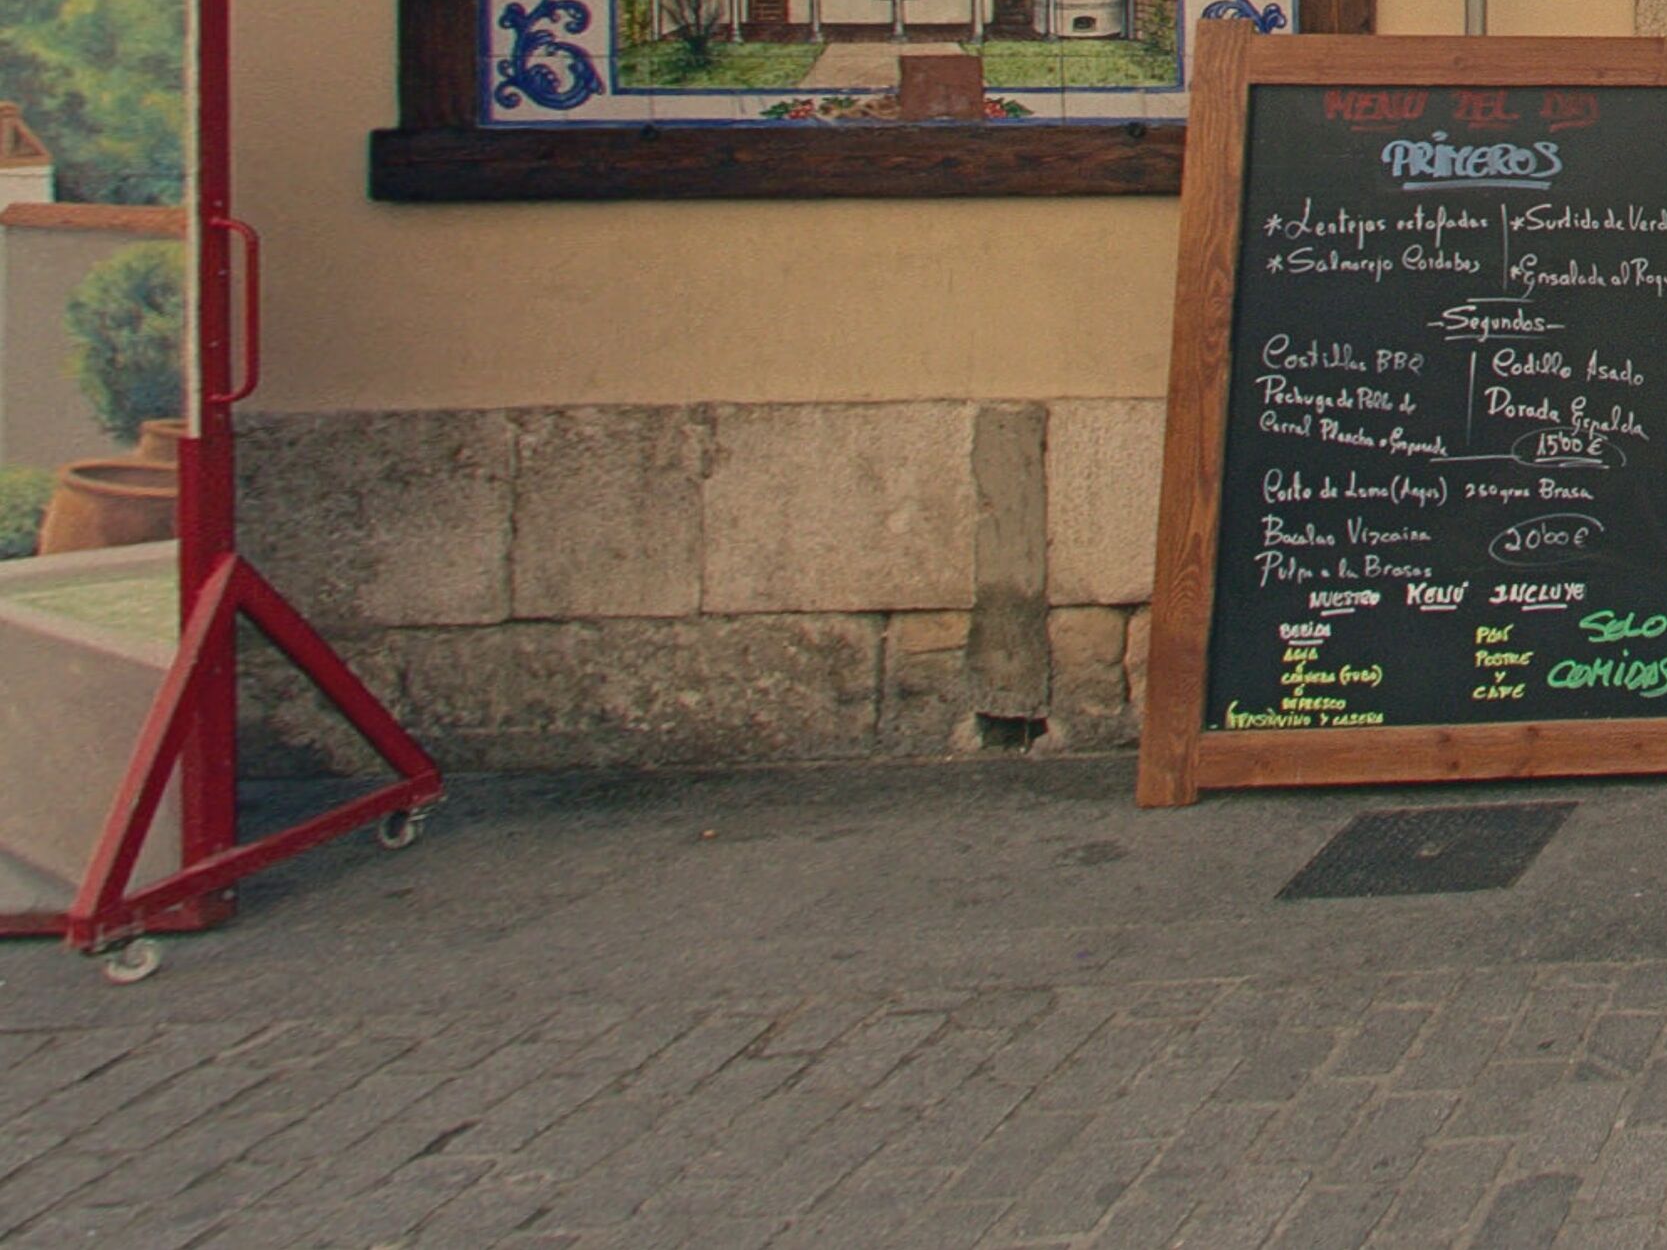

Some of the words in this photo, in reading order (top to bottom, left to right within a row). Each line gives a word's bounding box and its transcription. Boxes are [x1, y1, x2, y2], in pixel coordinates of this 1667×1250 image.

[1284, 196, 1387, 250] Lentejas
[1396, 204, 1489, 248] estofadas
[1524, 203, 1600, 231] Surtido
[1603, 207, 1625, 231] de
[1286, 246, 1394, 283] Salmorejo
[1518, 253, 1607, 300] Ensalada
[1610, 261, 1630, 287] al
[1263, 333, 1367, 372] Costillas
[1376, 349, 1424, 376] BBQ
[1491, 347, 1573, 380] Codillo
[1586, 349, 1645, 386] Asado
[1255, 374, 1334, 415] Pechuga
[1336, 388, 1354, 409] de
[1399, 392, 1417, 415] de
[1484, 386, 1561, 423] Dorada
[1319, 475, 1338, 499] de
[1538, 477, 1595, 501] Brasa
[1260, 513, 1336, 547] Bacalao
[1573, 527, 1590, 549] €
[1339, 557, 1359, 579] la
[1308, 589, 1382, 609] NUESTRO
[1488, 582, 1586, 604] INCLUYE
[1474, 650, 1535, 668] POSTRE
